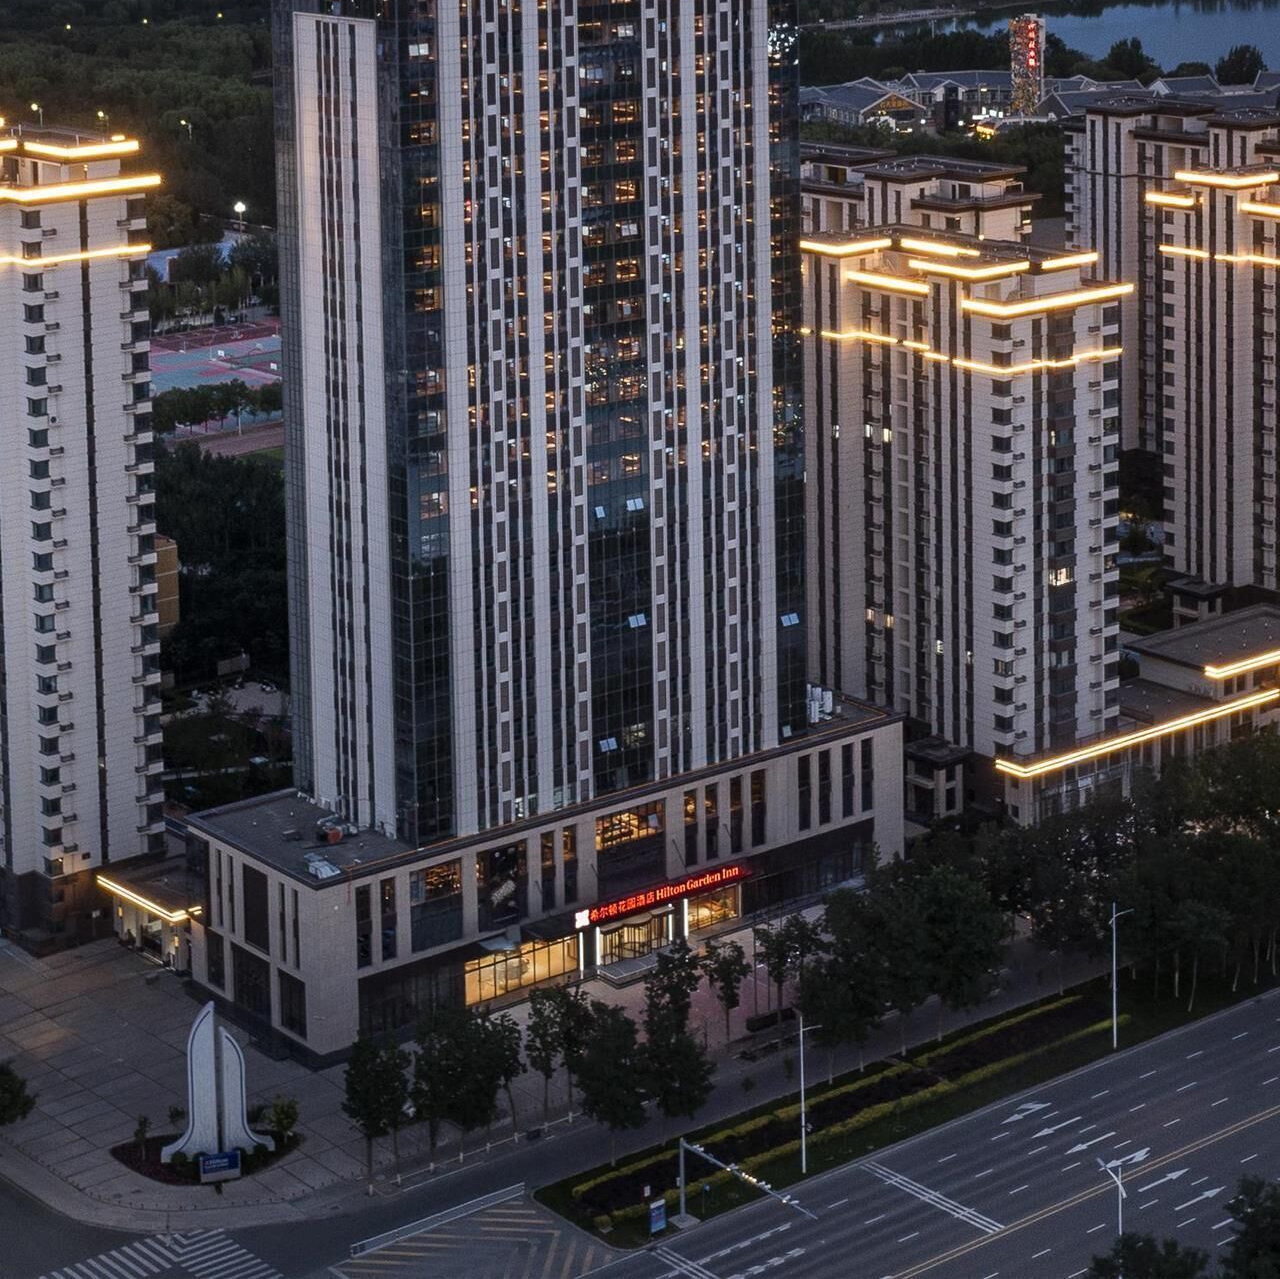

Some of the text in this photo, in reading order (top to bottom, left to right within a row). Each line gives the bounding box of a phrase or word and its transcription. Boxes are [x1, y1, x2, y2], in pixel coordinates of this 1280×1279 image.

[590, 866, 739, 921] 希尔顿花园酒店 Hilton Garden Inn
